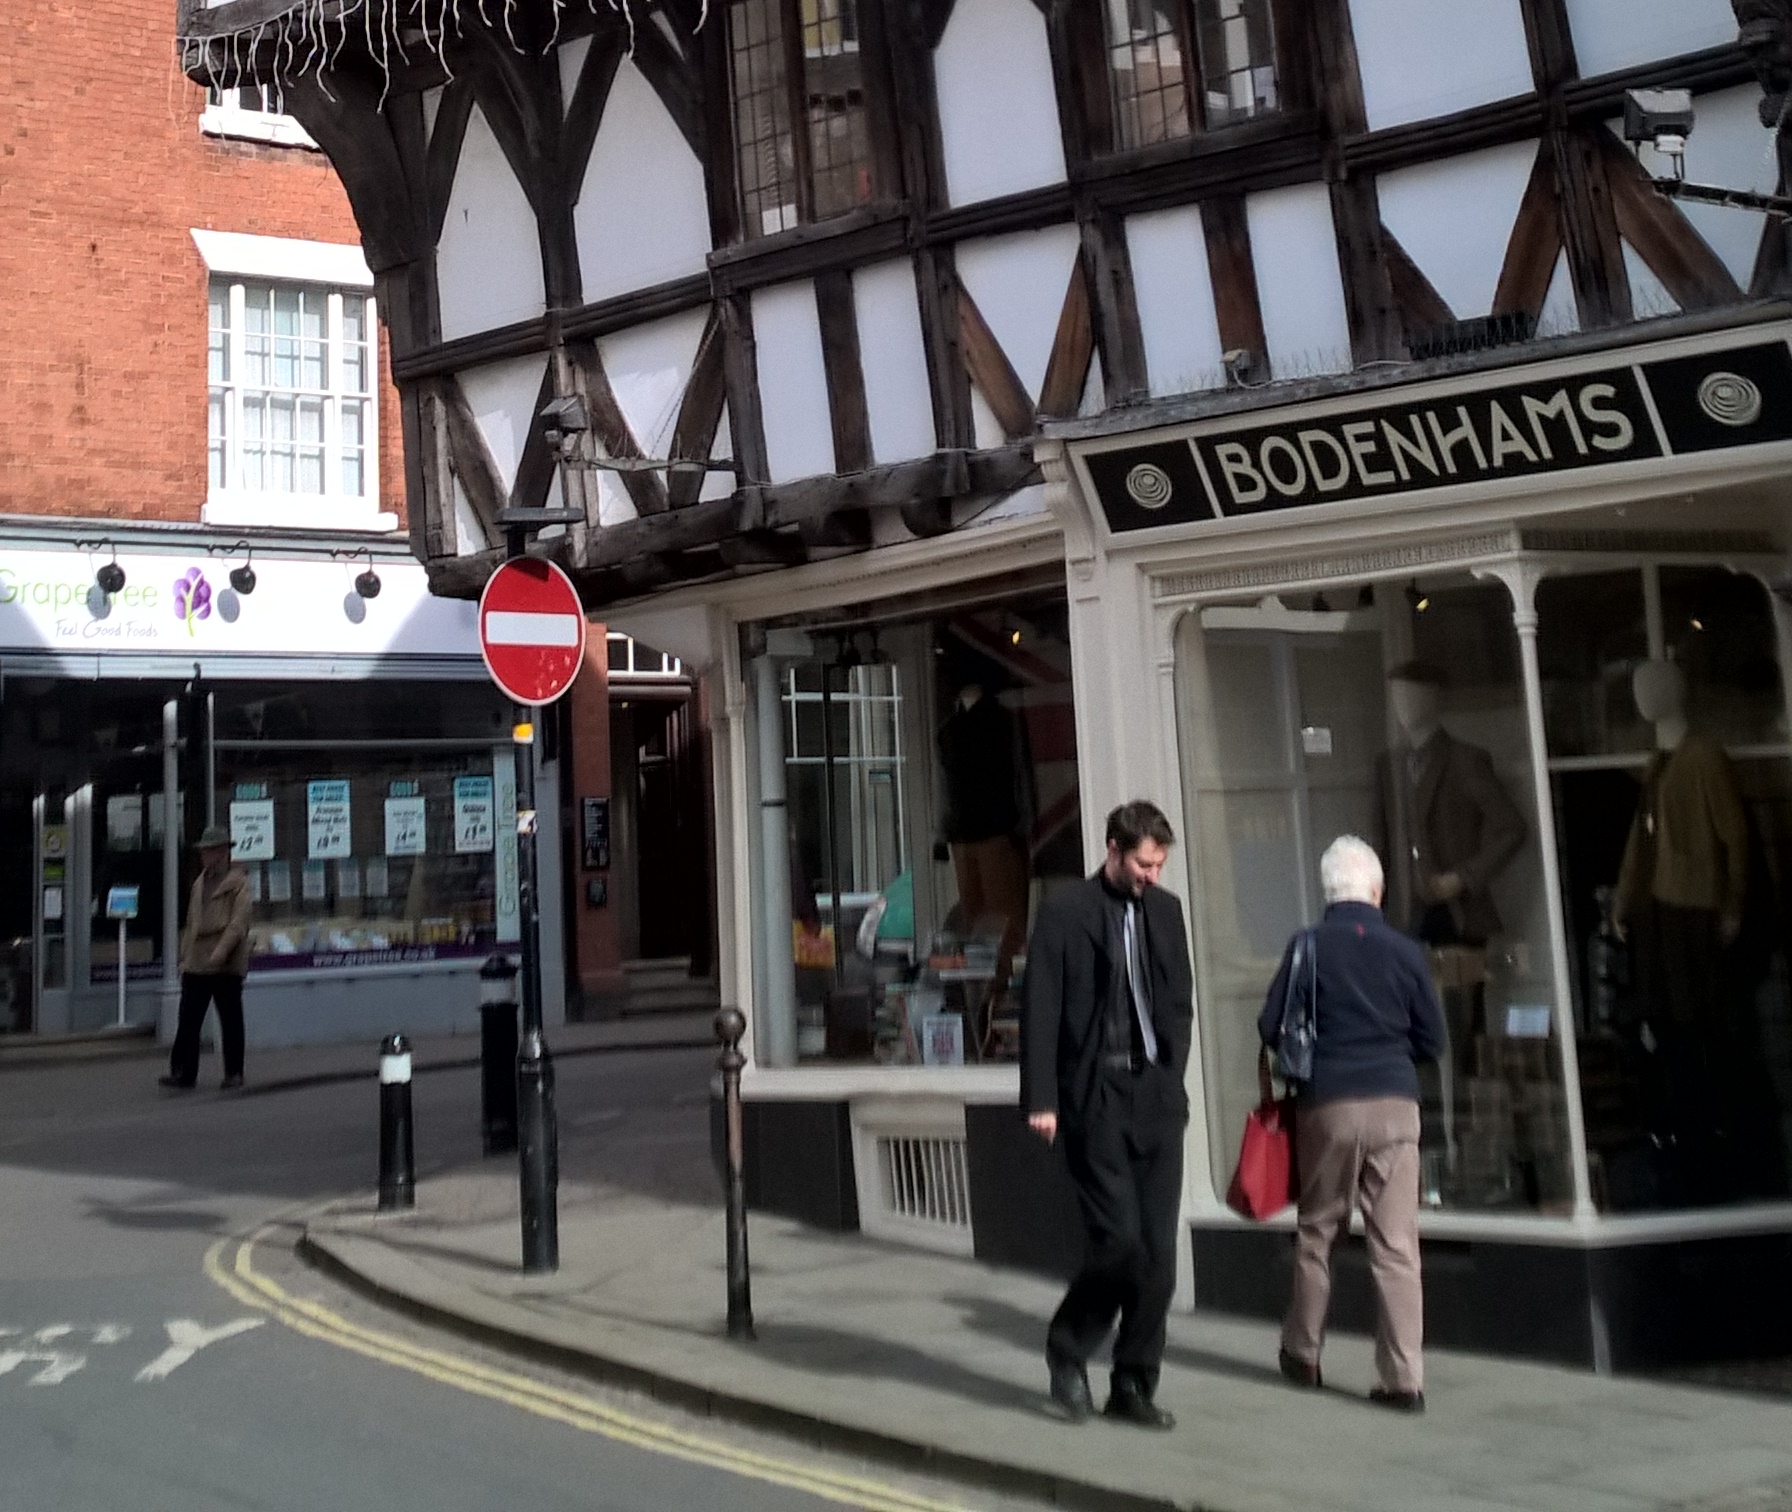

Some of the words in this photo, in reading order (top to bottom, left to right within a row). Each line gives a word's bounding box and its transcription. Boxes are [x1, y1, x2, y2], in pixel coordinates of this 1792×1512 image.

[1214, 384, 1634, 505] BODENHAMS
[55, 619, 78, 639] Feel
[83, 619, 122, 639] Good
[126, 620, 158, 640] Foods
